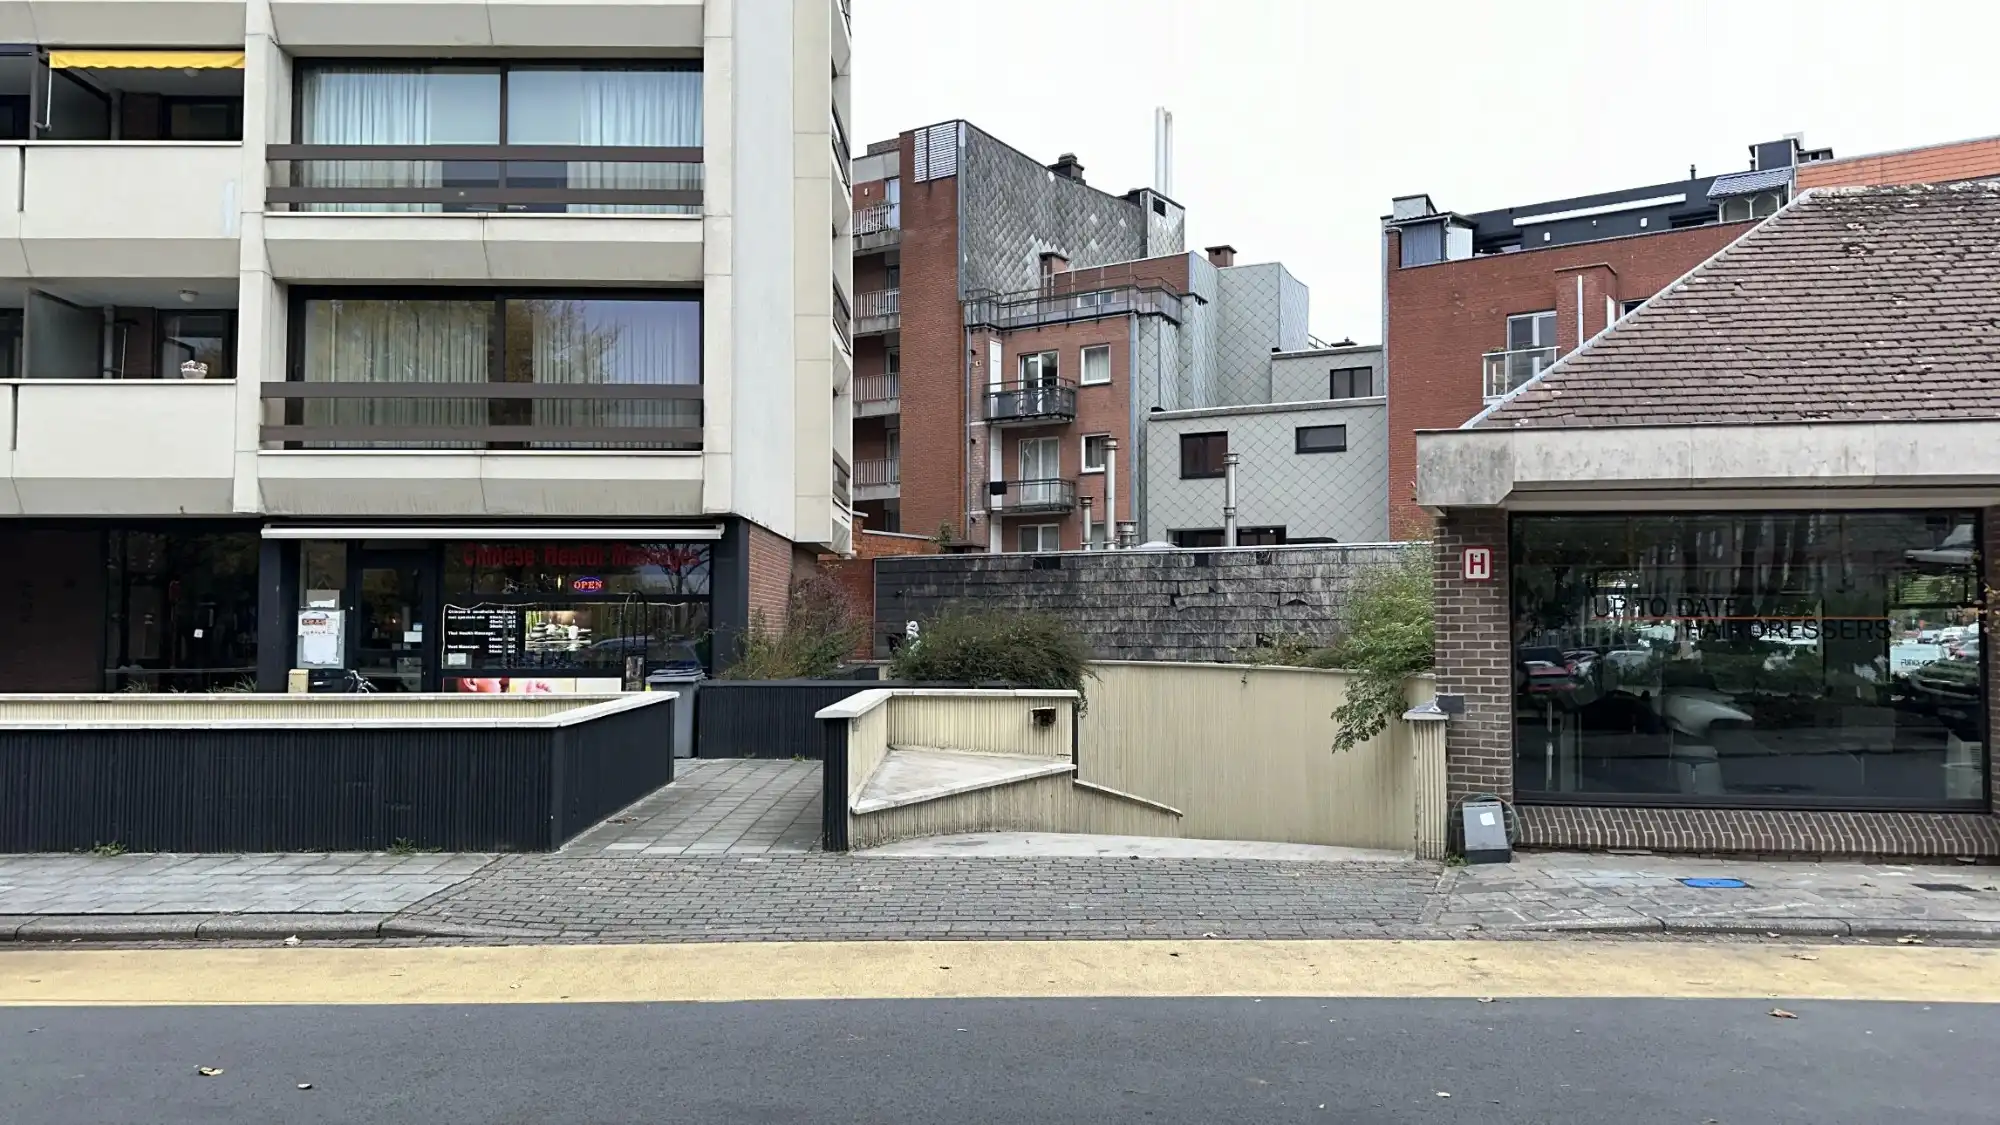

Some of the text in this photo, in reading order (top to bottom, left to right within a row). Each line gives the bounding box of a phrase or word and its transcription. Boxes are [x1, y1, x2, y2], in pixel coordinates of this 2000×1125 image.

[463, 543, 535, 567] Chinese
[545, 543, 604, 567] Health
[573, 580, 602, 590] OPEN
[1595, 598, 1738, 617] UP TO DATE
[1685, 620, 1744, 639] HAIR
